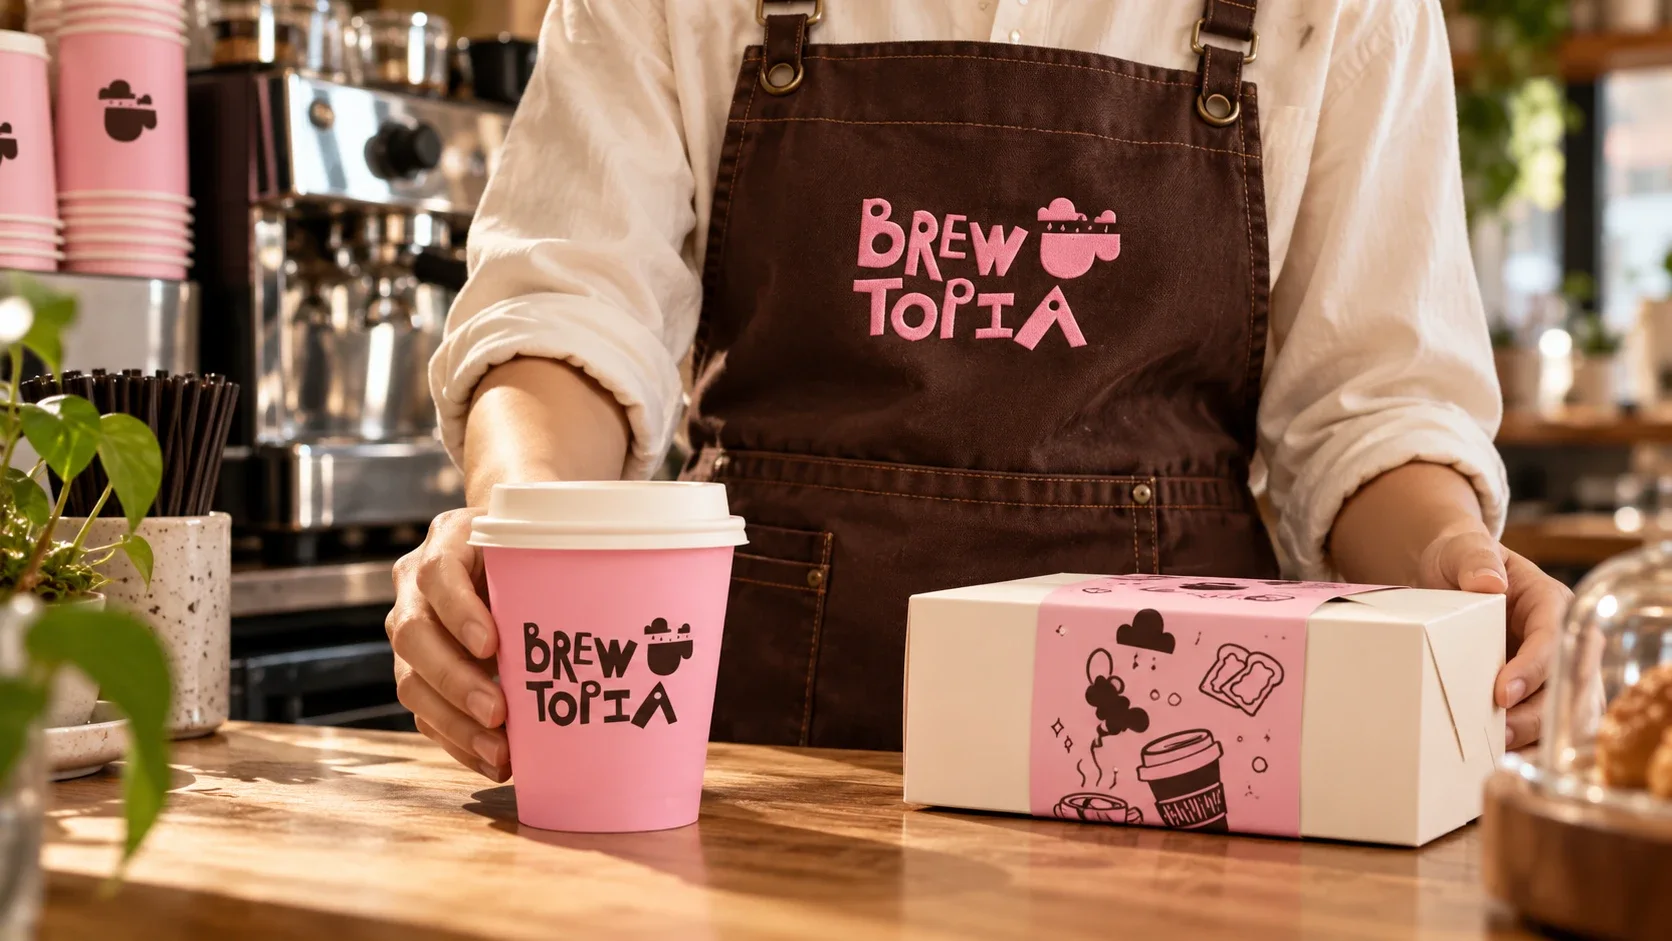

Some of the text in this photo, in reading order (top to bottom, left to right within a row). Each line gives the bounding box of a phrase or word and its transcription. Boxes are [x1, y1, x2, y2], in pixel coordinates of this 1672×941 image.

[857, 197, 1029, 282] BREW
[853, 277, 1088, 351] TOPIA
[523, 622, 638, 684] BREW
[525, 680, 678, 729] TOPIA
